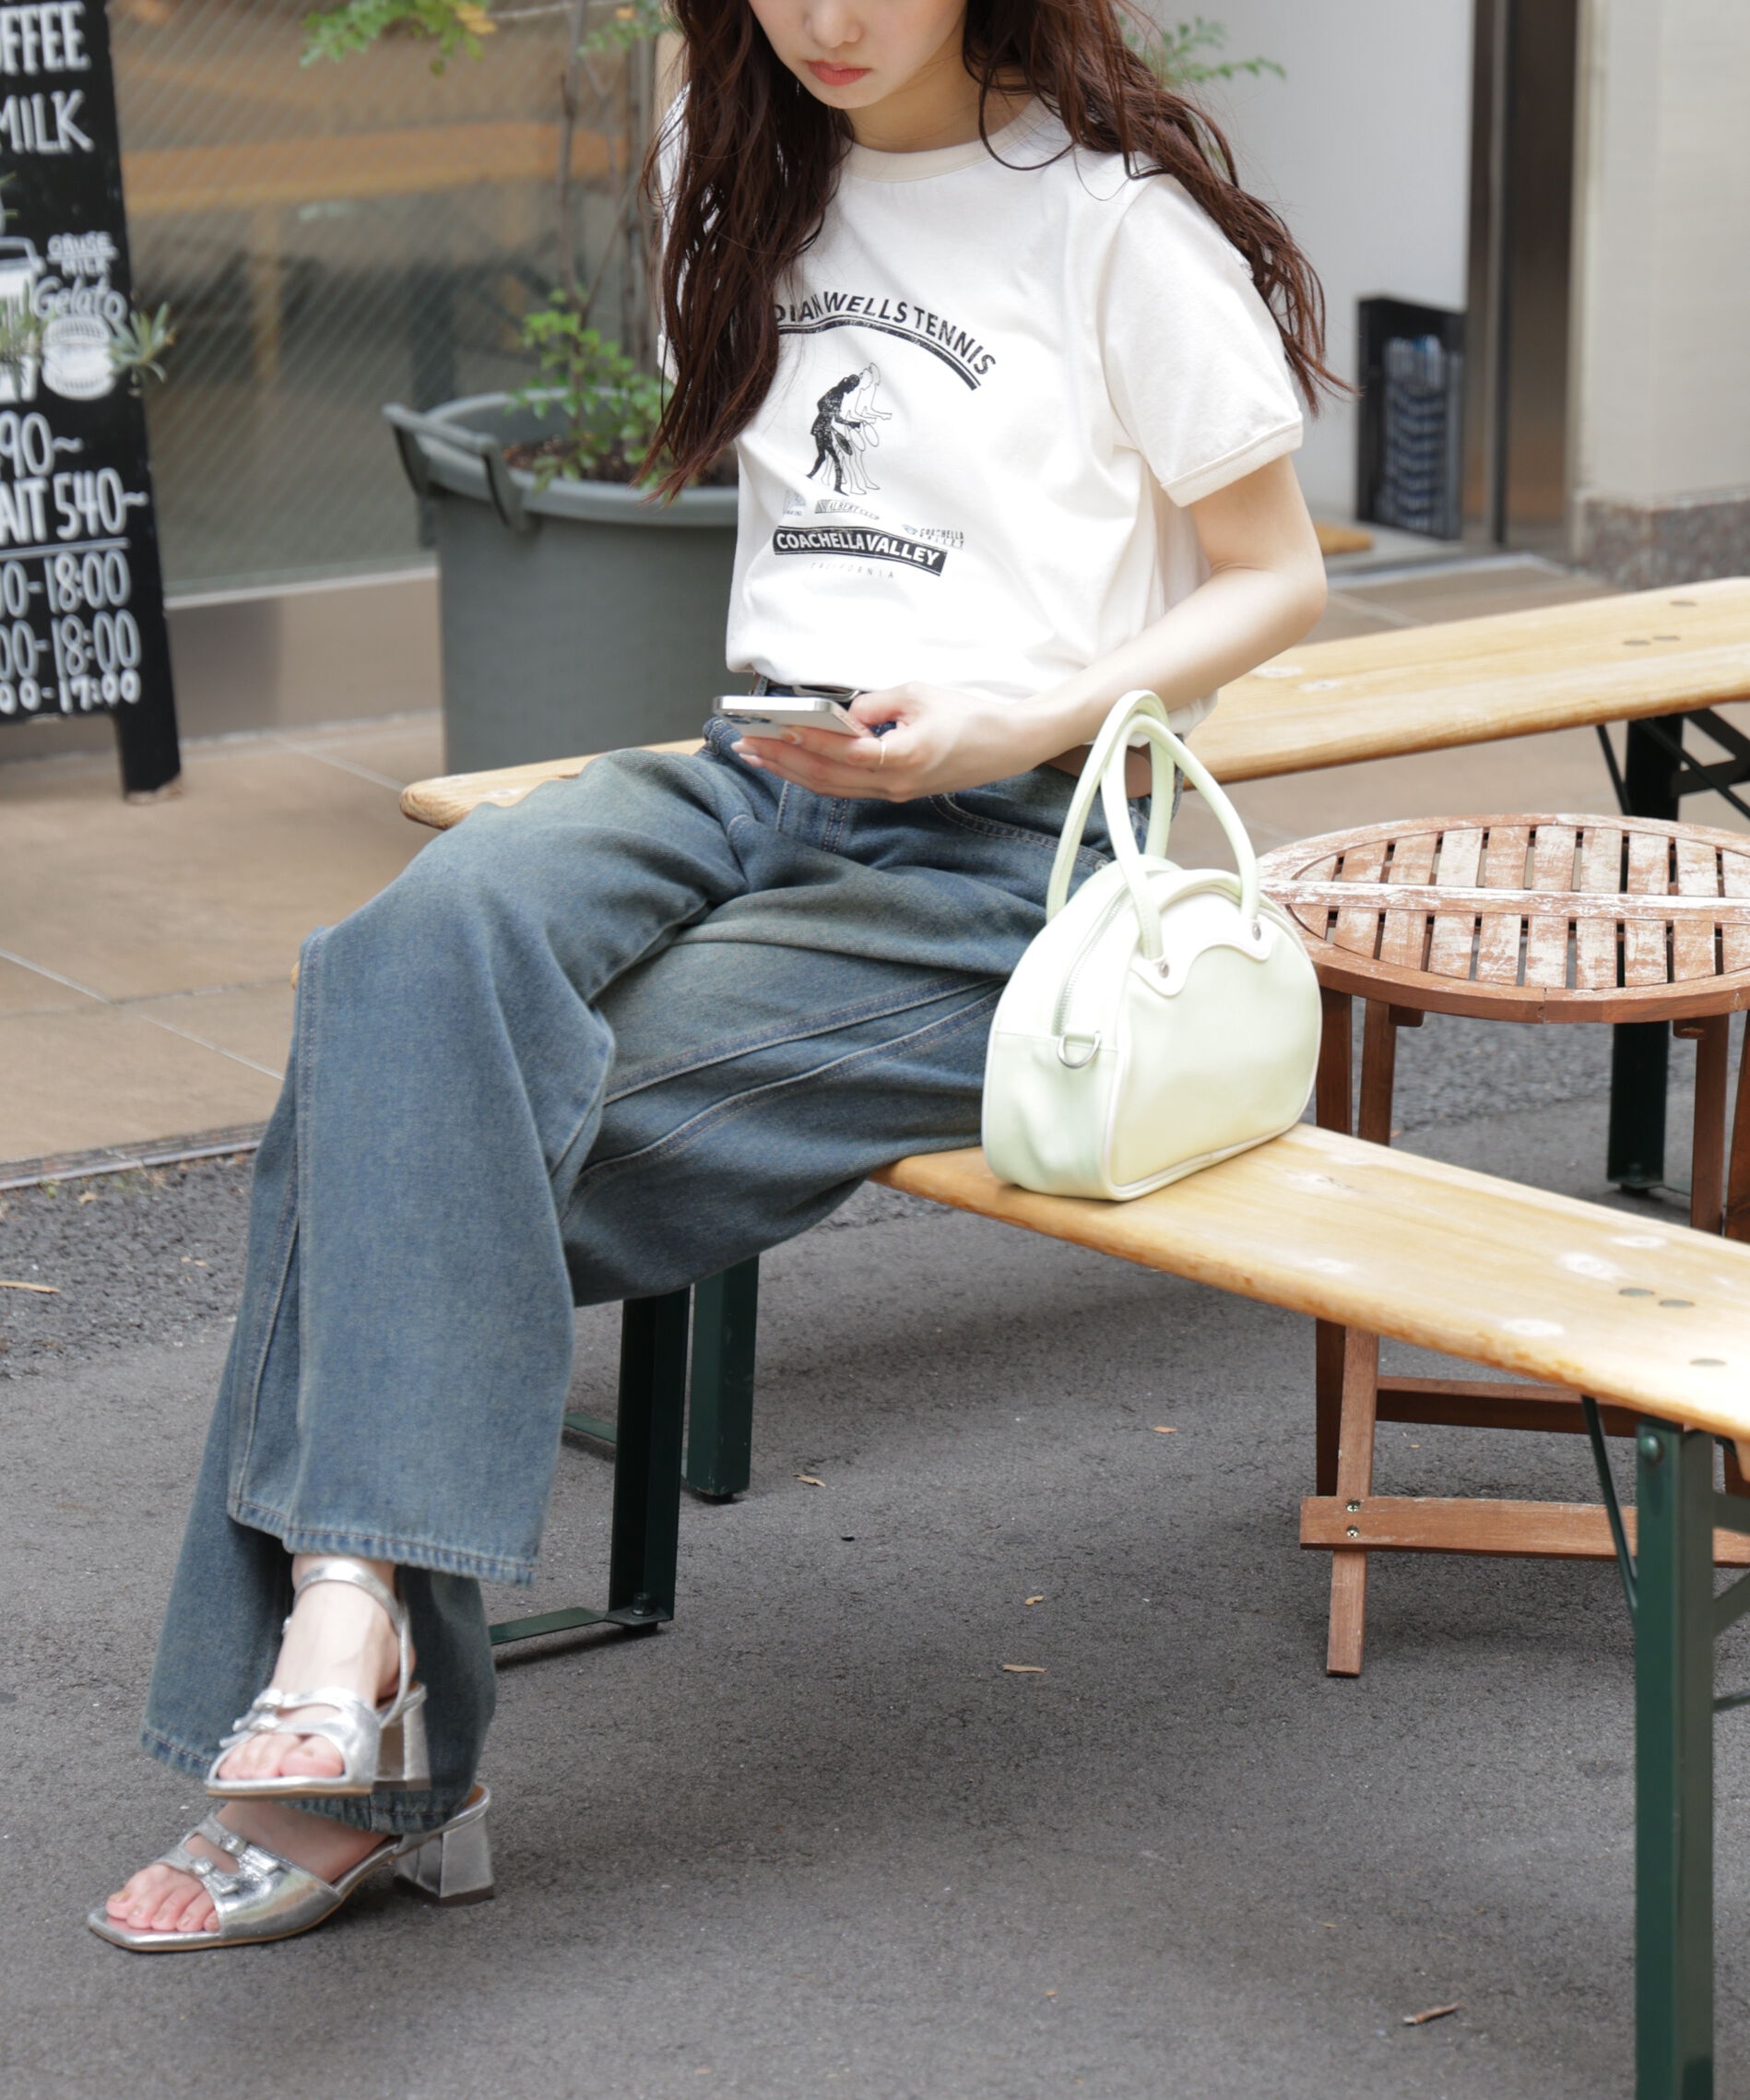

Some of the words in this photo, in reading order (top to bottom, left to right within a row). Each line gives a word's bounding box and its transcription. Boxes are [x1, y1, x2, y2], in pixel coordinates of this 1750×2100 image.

[0, 1, 90, 76] FFEE
[823, 291, 907, 323] WELLS
[914, 305, 997, 375] TENNIS
[775, 531, 867, 551] COACHELLA
[867, 534, 940, 565] VALLEY
[0, 550, 132, 618] 0-18:00
